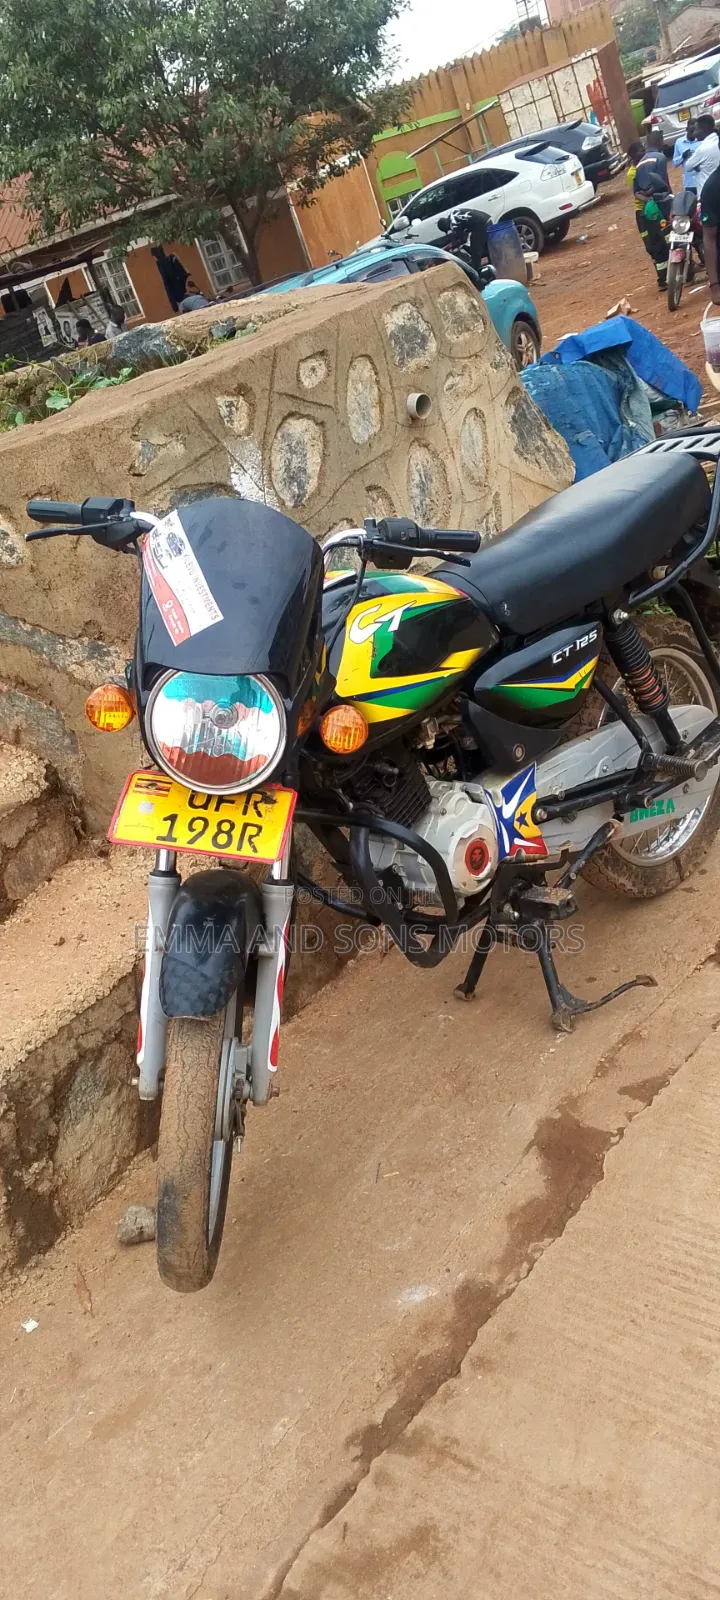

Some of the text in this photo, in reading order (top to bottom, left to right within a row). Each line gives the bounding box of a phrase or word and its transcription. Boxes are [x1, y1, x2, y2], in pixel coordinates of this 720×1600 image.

[191, 576, 220, 621] INVESTMENTS
[348, 599, 417, 645] CT
[551, 629, 598, 664] CT 125
[155, 812, 263, 854] 198R
